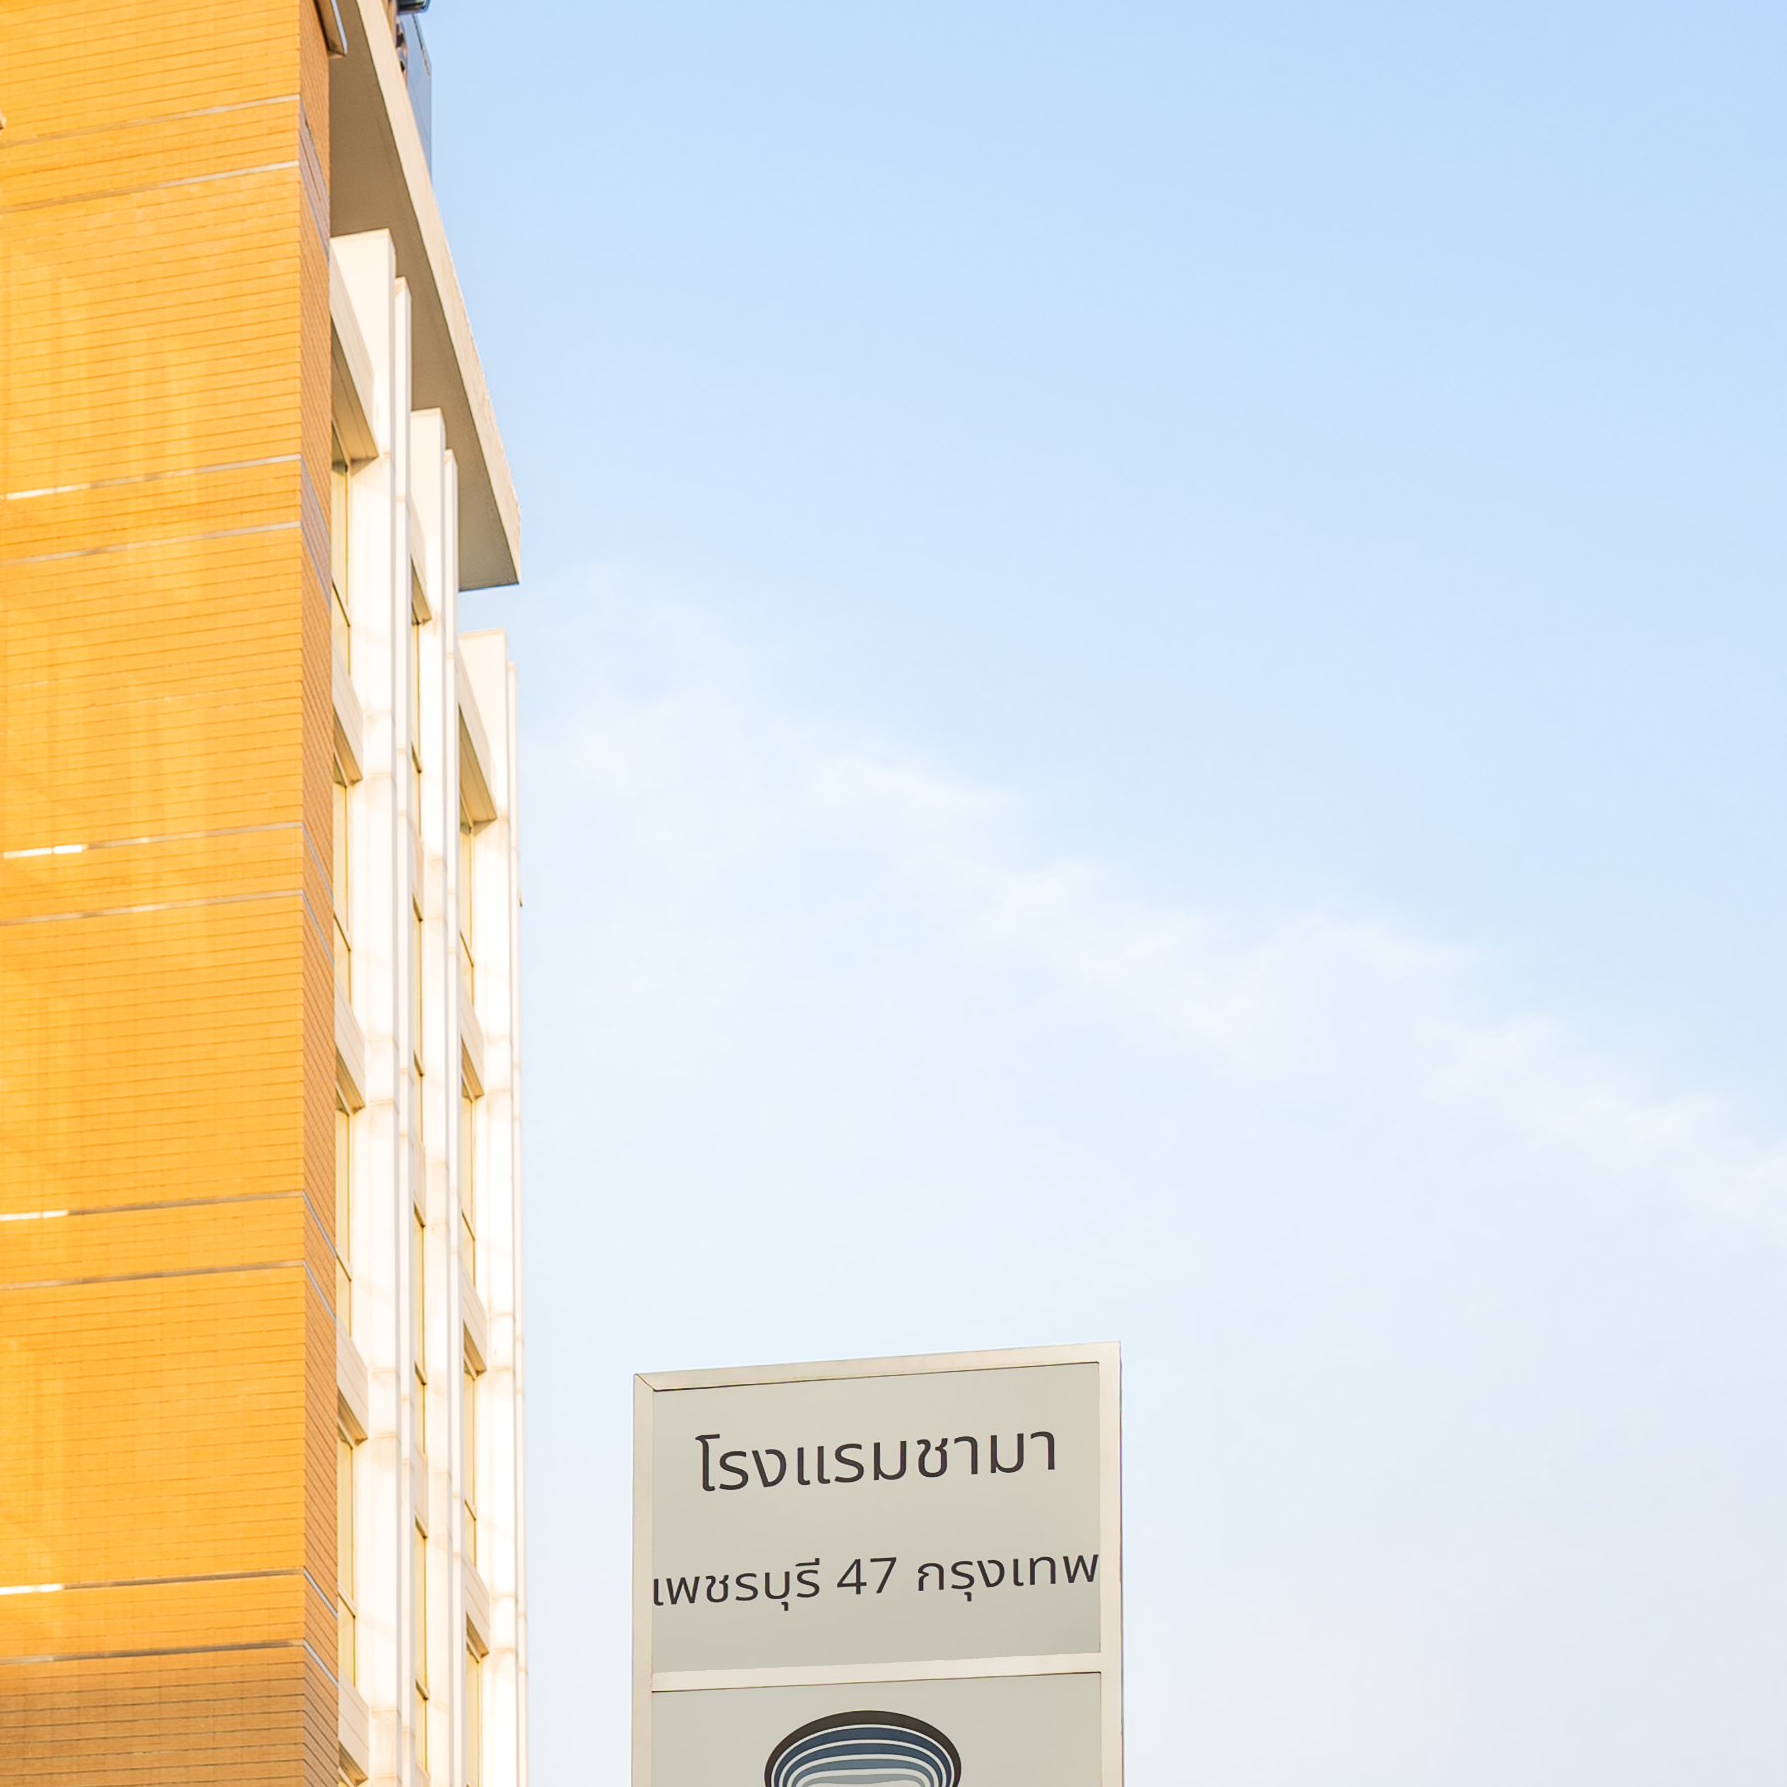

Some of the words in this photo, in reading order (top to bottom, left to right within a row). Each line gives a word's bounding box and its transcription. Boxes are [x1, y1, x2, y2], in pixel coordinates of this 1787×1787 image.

[695, 1429, 1057, 1493] โรงแรมชามา
[652, 1557, 821, 1612] เพชรบุรี
[836, 1556, 898, 1596] 47
[917, 1553, 1100, 1603] กรุงเทพ
